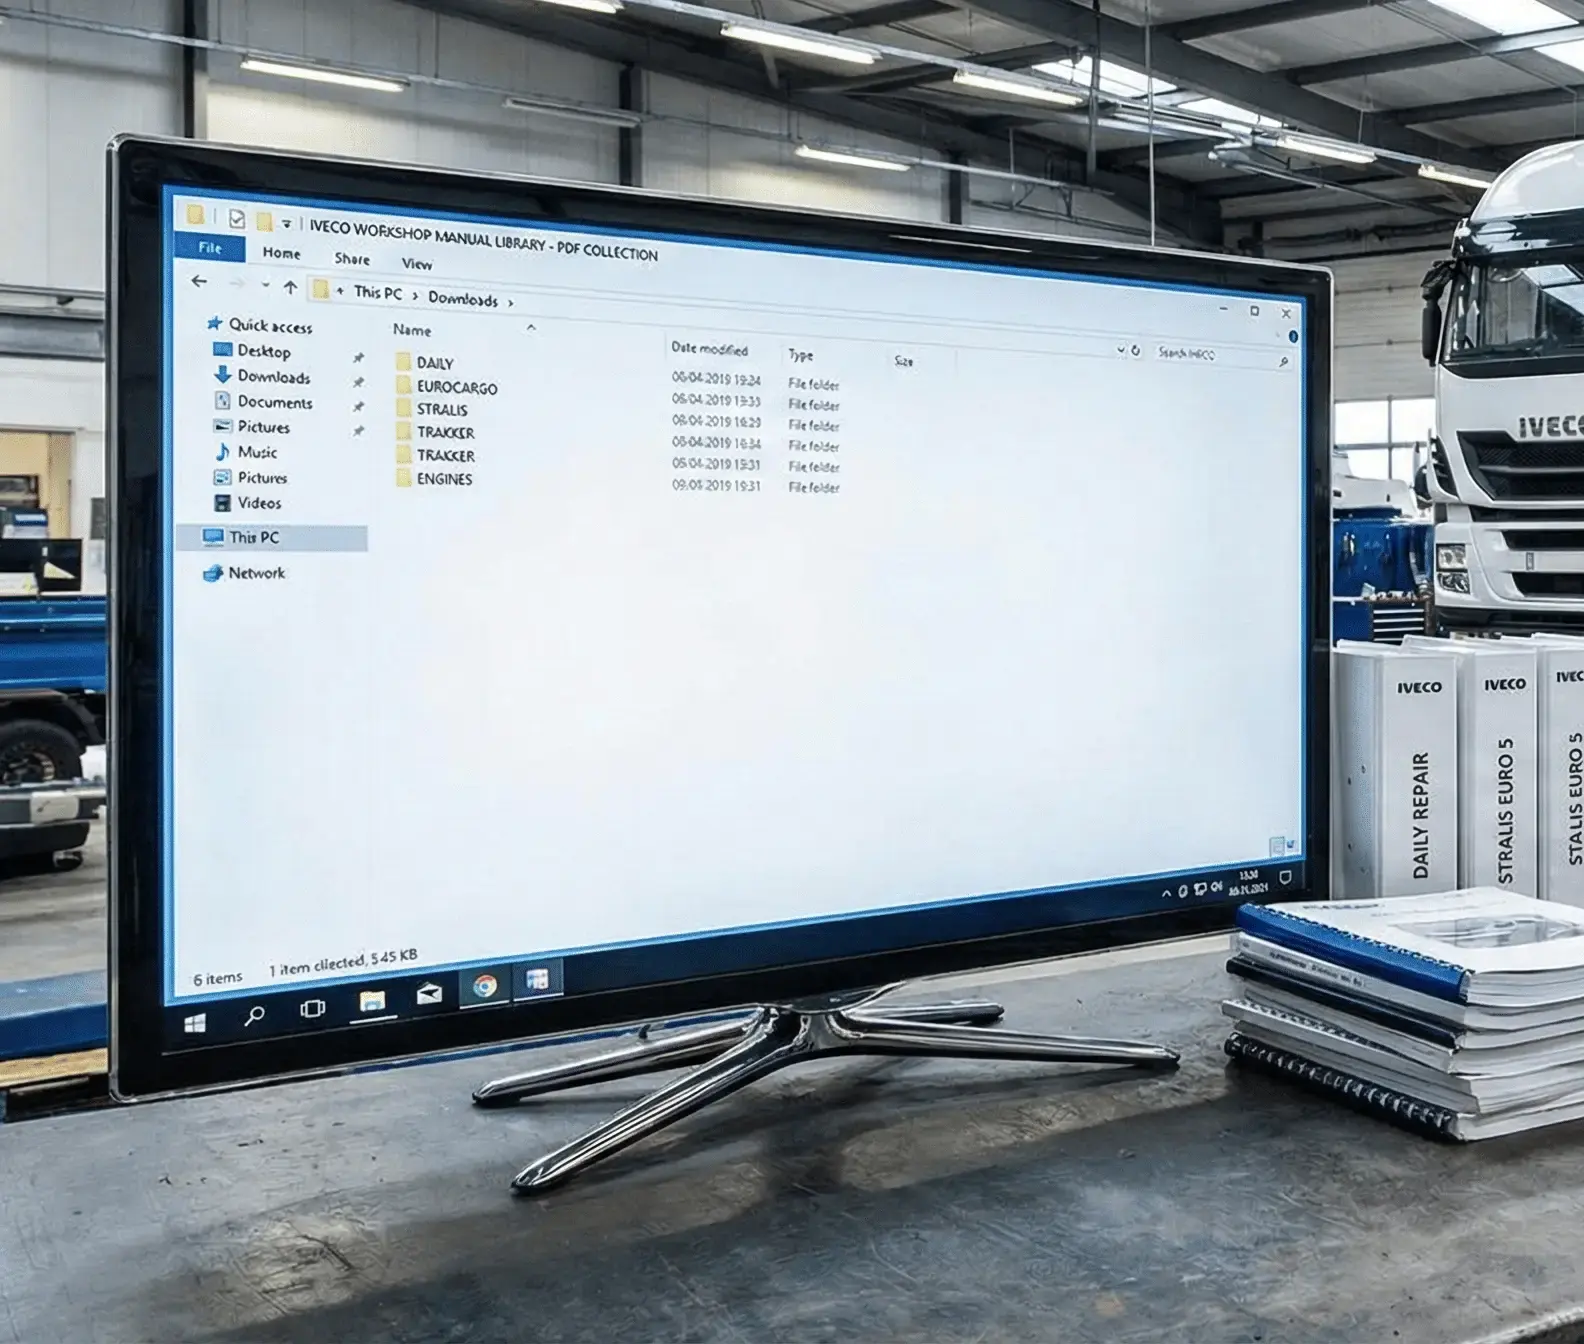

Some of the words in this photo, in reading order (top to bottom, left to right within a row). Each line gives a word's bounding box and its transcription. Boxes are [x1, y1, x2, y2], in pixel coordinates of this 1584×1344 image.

[310, 219, 350, 234] IVECO
[353, 223, 432, 240] WORKSHOP
[435, 230, 492, 247] MANUAL
[495, 235, 546, 251] LIBRARY
[557, 241, 580, 254] PDF
[583, 243, 658, 261] COLLECTION
[198, 241, 222, 254] File
[263, 247, 301, 260] Home
[335, 252, 370, 266] Share
[402, 257, 433, 271] View
[354, 285, 381, 299] This
[384, 287, 403, 301] PC
[229, 317, 268, 332] Quick
[272, 323, 313, 334] access
[393, 323, 432, 337] Name
[238, 344, 291, 360] Desktop
[672, 341, 697, 354] Date
[789, 348, 813, 363] Type
[894, 355, 913, 368] Size
[417, 356, 454, 370] DAILY
[238, 369, 311, 386] Downloads
[417, 380, 498, 395] EUROCARGO
[239, 395, 313, 410] Documents
[417, 402, 468, 417] STRALIS
[239, 421, 290, 435] Pictures
[239, 446, 278, 460] Music
[239, 472, 288, 485] Pictures
[417, 472, 473, 486] ENGINES
[238, 497, 282, 510] Videos
[230, 531, 257, 545] This
[261, 531, 280, 545] PC
[229, 567, 285, 580] Network
[1398, 681, 1442, 694] IVECO
[1485, 678, 1527, 691] IVECO
[1498, 738, 1514, 750] 5
[1569, 732, 1583, 744] 5
[1498, 753, 1514, 807] EURO
[1569, 748, 1583, 799] EURO
[1413, 752, 1429, 821] REPAIR
[1569, 804, 1583, 865] STALIS
[1413, 826, 1429, 879] DAILY
[1498, 811, 1514, 884] STRALIS
[269, 965, 275, 978] 1
[280, 963, 311, 976] item
[400, 948, 418, 961] KB
[193, 974, 203, 987] 6
[206, 972, 243, 985] items
